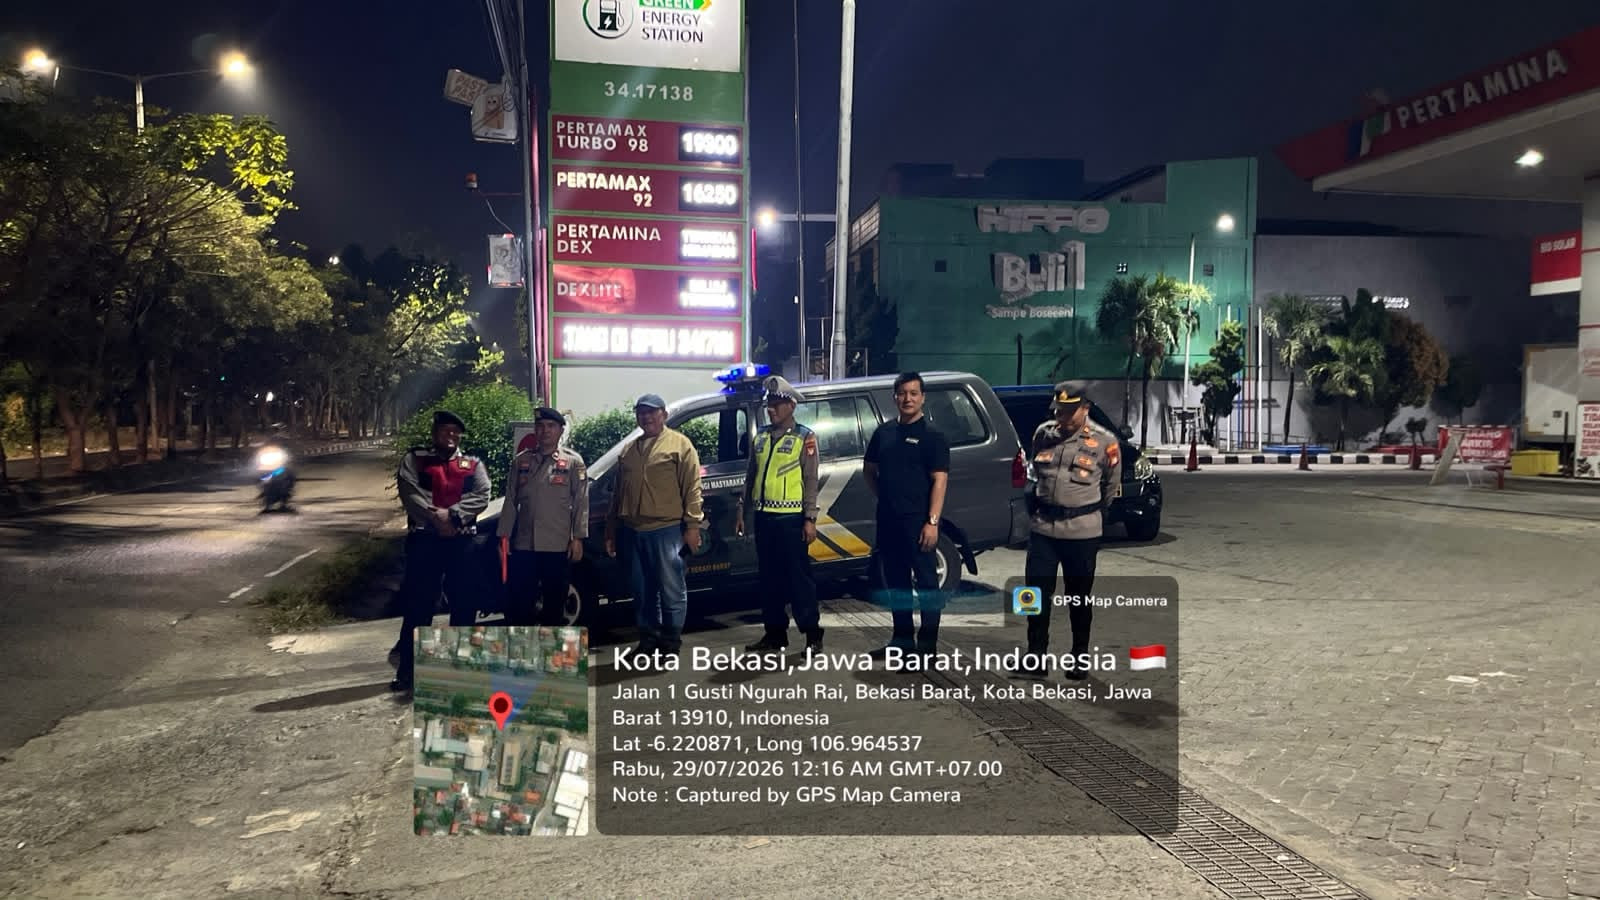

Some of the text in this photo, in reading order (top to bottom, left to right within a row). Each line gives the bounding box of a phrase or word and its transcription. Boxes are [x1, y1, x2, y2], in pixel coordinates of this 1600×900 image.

[642, 10, 701, 26] ENERGY
[642, 26, 703, 43] STATION
[604, 81, 693, 101] 34.17138
[1396, 49, 1568, 129] PERTAMINA
[556, 120, 647, 137] PERTAMAX
[556, 135, 648, 152] TURBO 98
[556, 172, 651, 192] PERTAMAX
[633, 193, 653, 207] 92
[556, 223, 661, 241] PERTAMINA
[556, 240, 592, 254] DEX
[556, 282, 622, 298] DEXLITE
